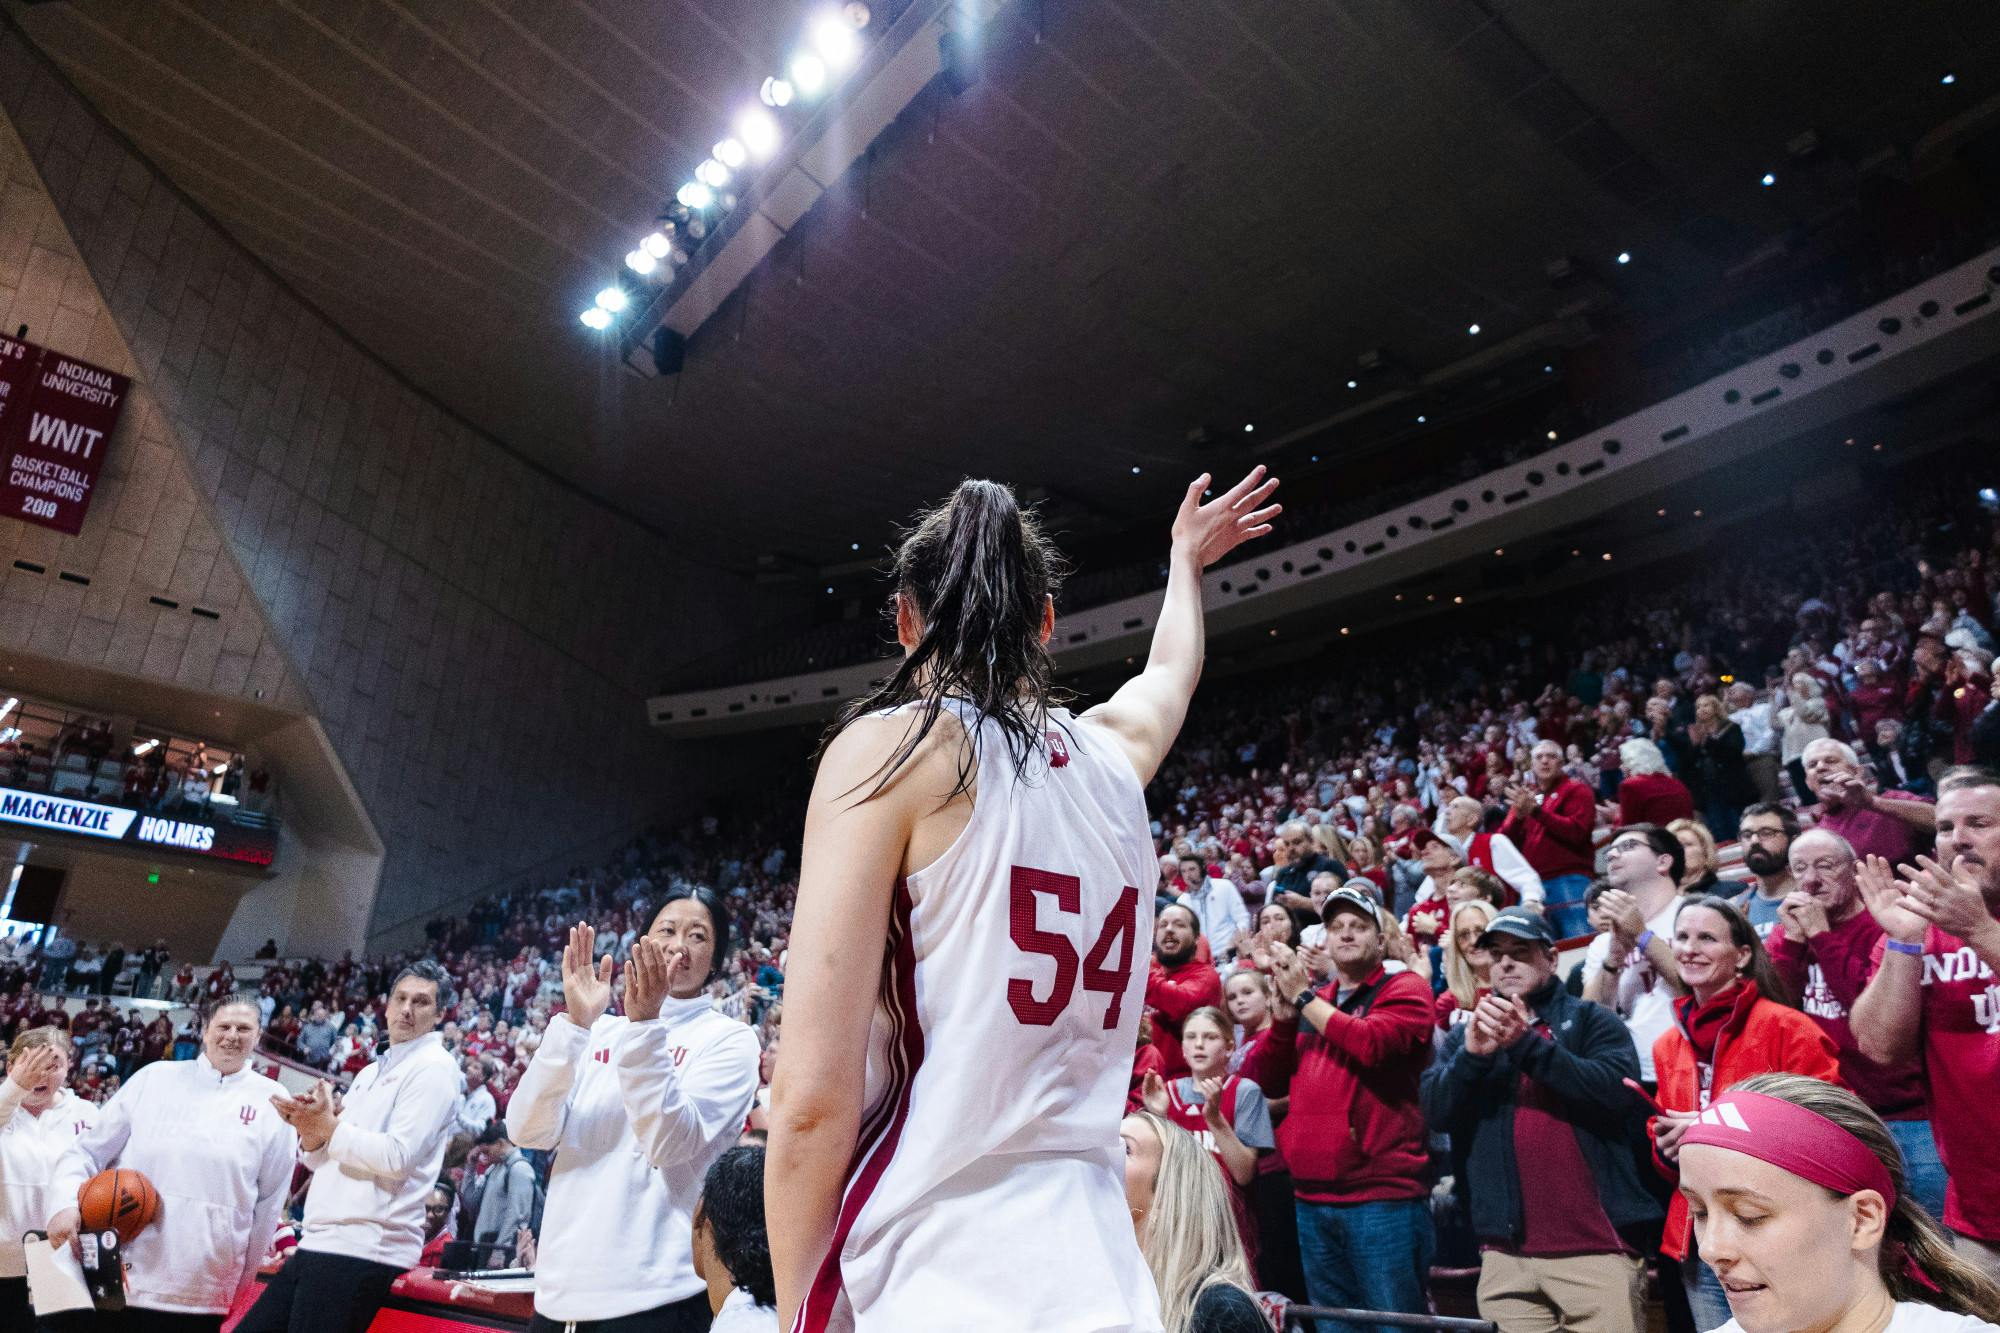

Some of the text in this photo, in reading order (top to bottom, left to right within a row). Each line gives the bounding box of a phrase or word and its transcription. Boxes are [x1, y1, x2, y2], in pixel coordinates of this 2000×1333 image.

[42, 372, 119, 408] UNIVERSITY
[57, 360, 113, 390] INDIANA
[28, 412, 104, 459] WNIT
[10, 470, 84, 502] CHAMPIONS
[11, 454, 90, 489] BASKETBALL
[22, 496, 58, 519] 2018
[0, 794, 216, 850] MACKENZIE HOLMES
[1007, 864, 1139, 1030] 54
